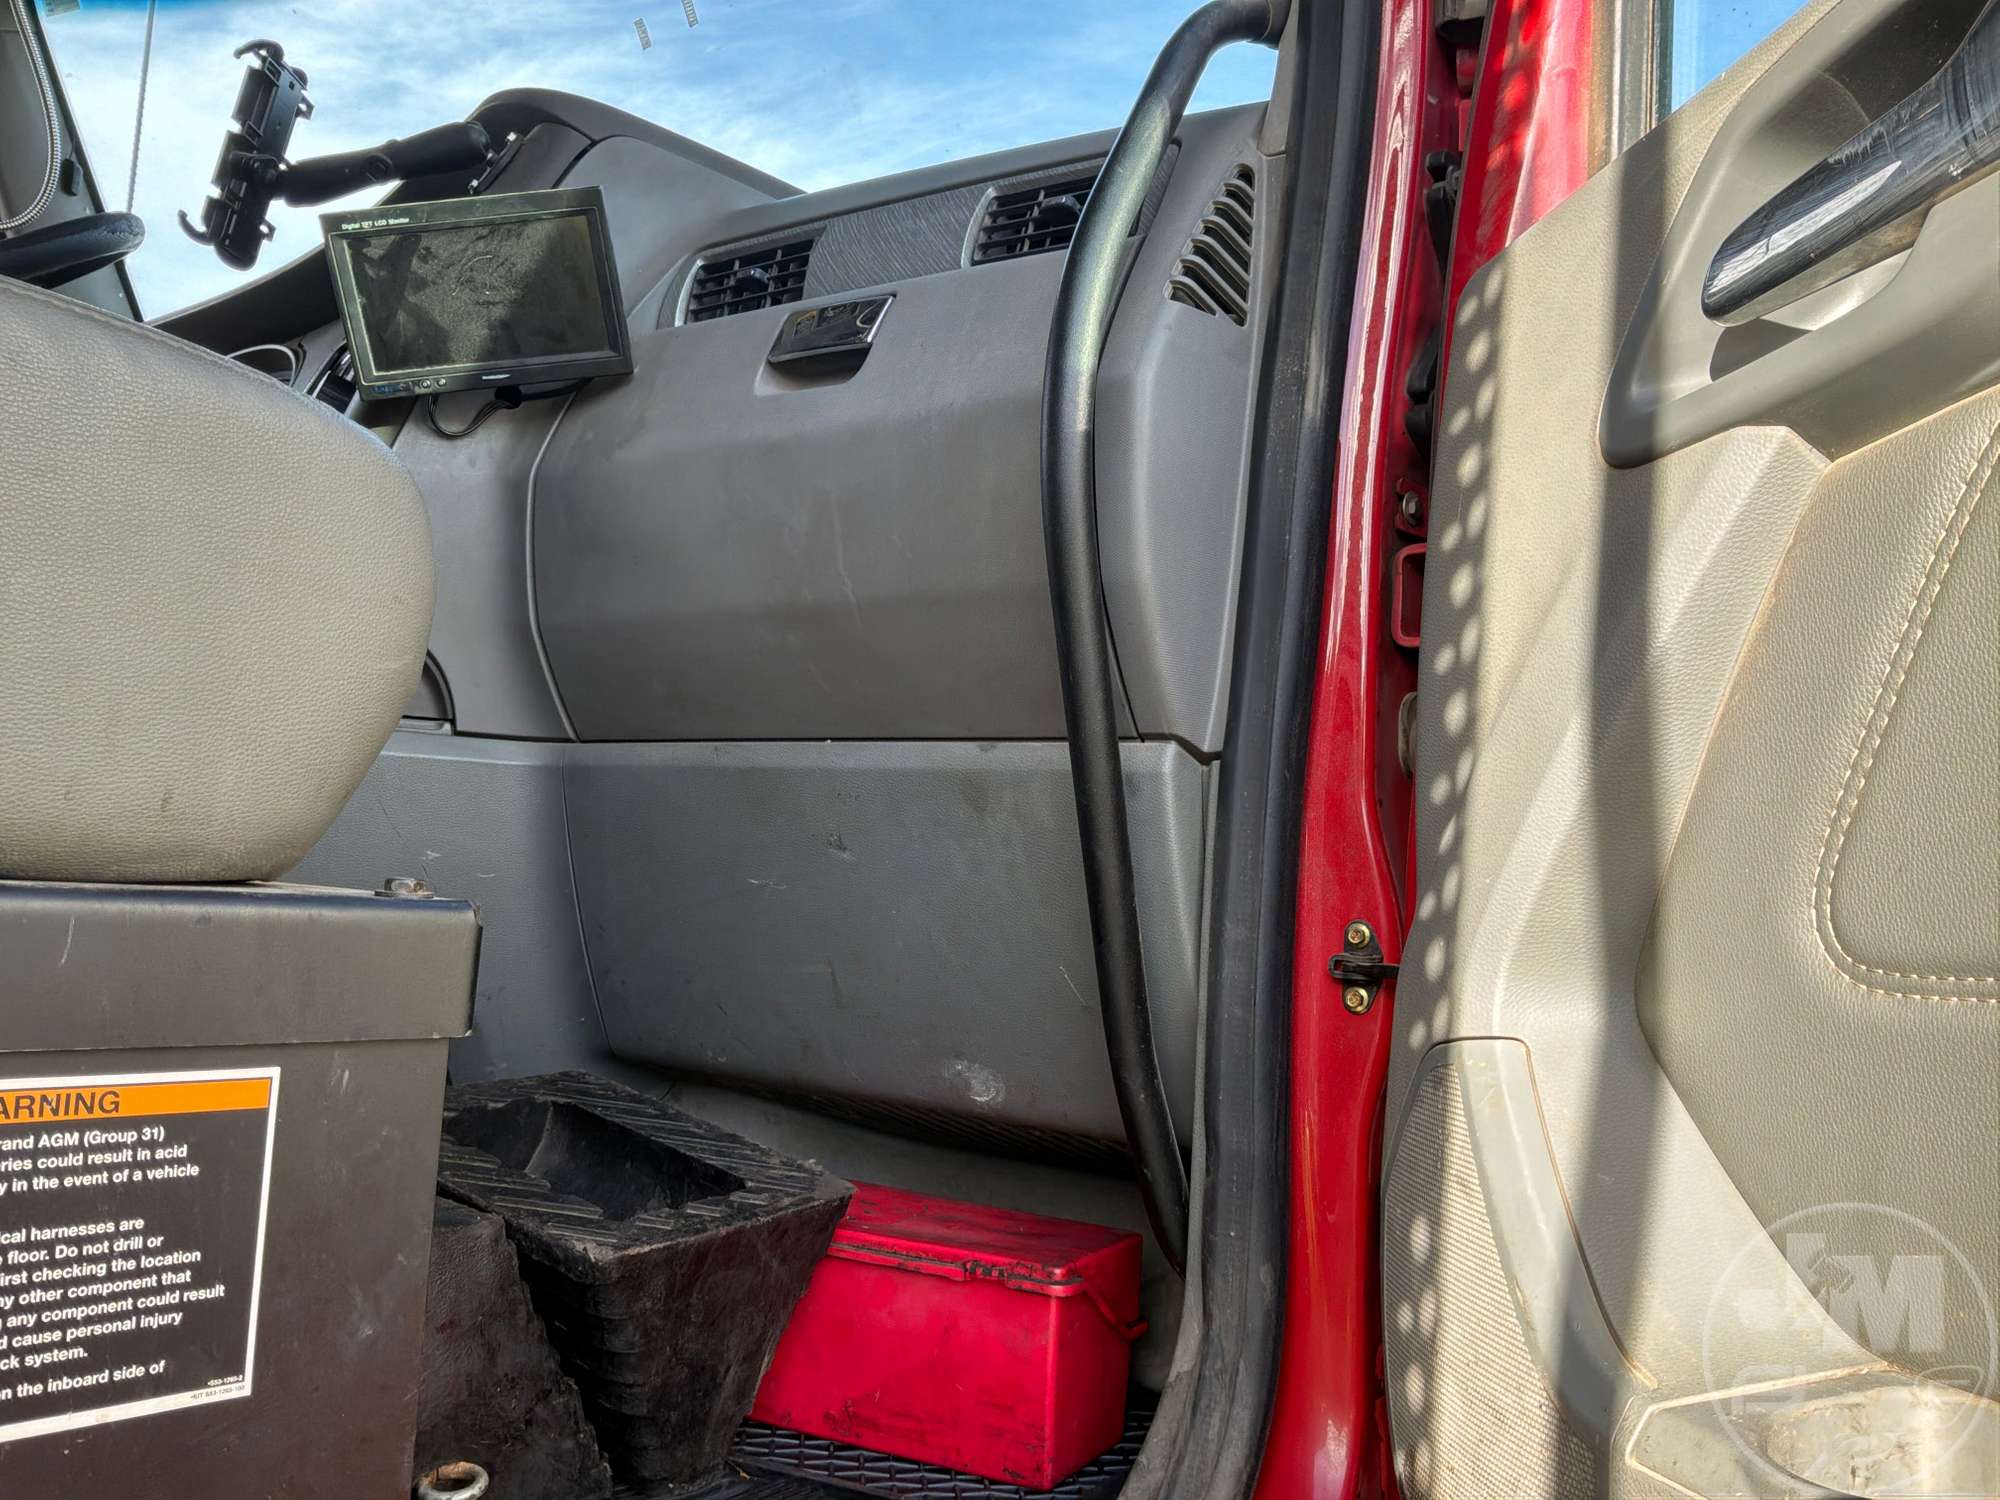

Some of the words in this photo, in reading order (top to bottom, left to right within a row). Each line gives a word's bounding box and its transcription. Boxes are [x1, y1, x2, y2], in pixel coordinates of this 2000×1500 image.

[0, 1135, 34, 1151] and
[38, 1131, 79, 1148] AGM
[84, 1130, 138, 1147] (Group
[141, 1126, 165, 1142] 31)
[37, 1152, 83, 1168] could
[87, 1148, 133, 1165] result
[136, 1148, 151, 1161] in
[154, 1144, 188, 1159] acid
[12, 1178, 28, 1192] in
[32, 1175, 59, 1190] the
[63, 1171, 109, 1187] event
[112, 1168, 130, 1183] of
[132, 1170, 143, 1181] a
[146, 1163, 200, 1180] vehicle
[30, 1221, 116, 1241] harnesses
[119, 1218, 145, 1231] are
[8, 1249, 50, 1265] floor.
[55, 1244, 78, 1259] Do
[82, 1240, 110, 1256] not
[113, 1236, 143, 1252] drill
[147, 1236, 164, 1248] or
[32, 1262, 107, 1282] checking
[111, 1258, 137, 1272] the
[140, 1250, 202, 1268] location
[19, 1288, 64, 1305] other
[67, 1274, 158, 1298] component
[161, 1270, 192, 1285] that
[6, 1313, 38, 1328] any
[41, 1297, 133, 1322] component
[137, 1290, 180, 1309] could
[183, 1284, 225, 1302] result
[12, 1330, 63, 1348] cause
[66, 1316, 137, 1342] personal
[140, 1312, 183, 1329] injury
[24, 1346, 89, 1368] system.
[0, 1387, 13, 1400] n
[16, 1382, 44, 1398] the
[47, 1369, 110, 1392] inboard
[112, 1365, 145, 1381] side
[149, 1360, 166, 1375] of
